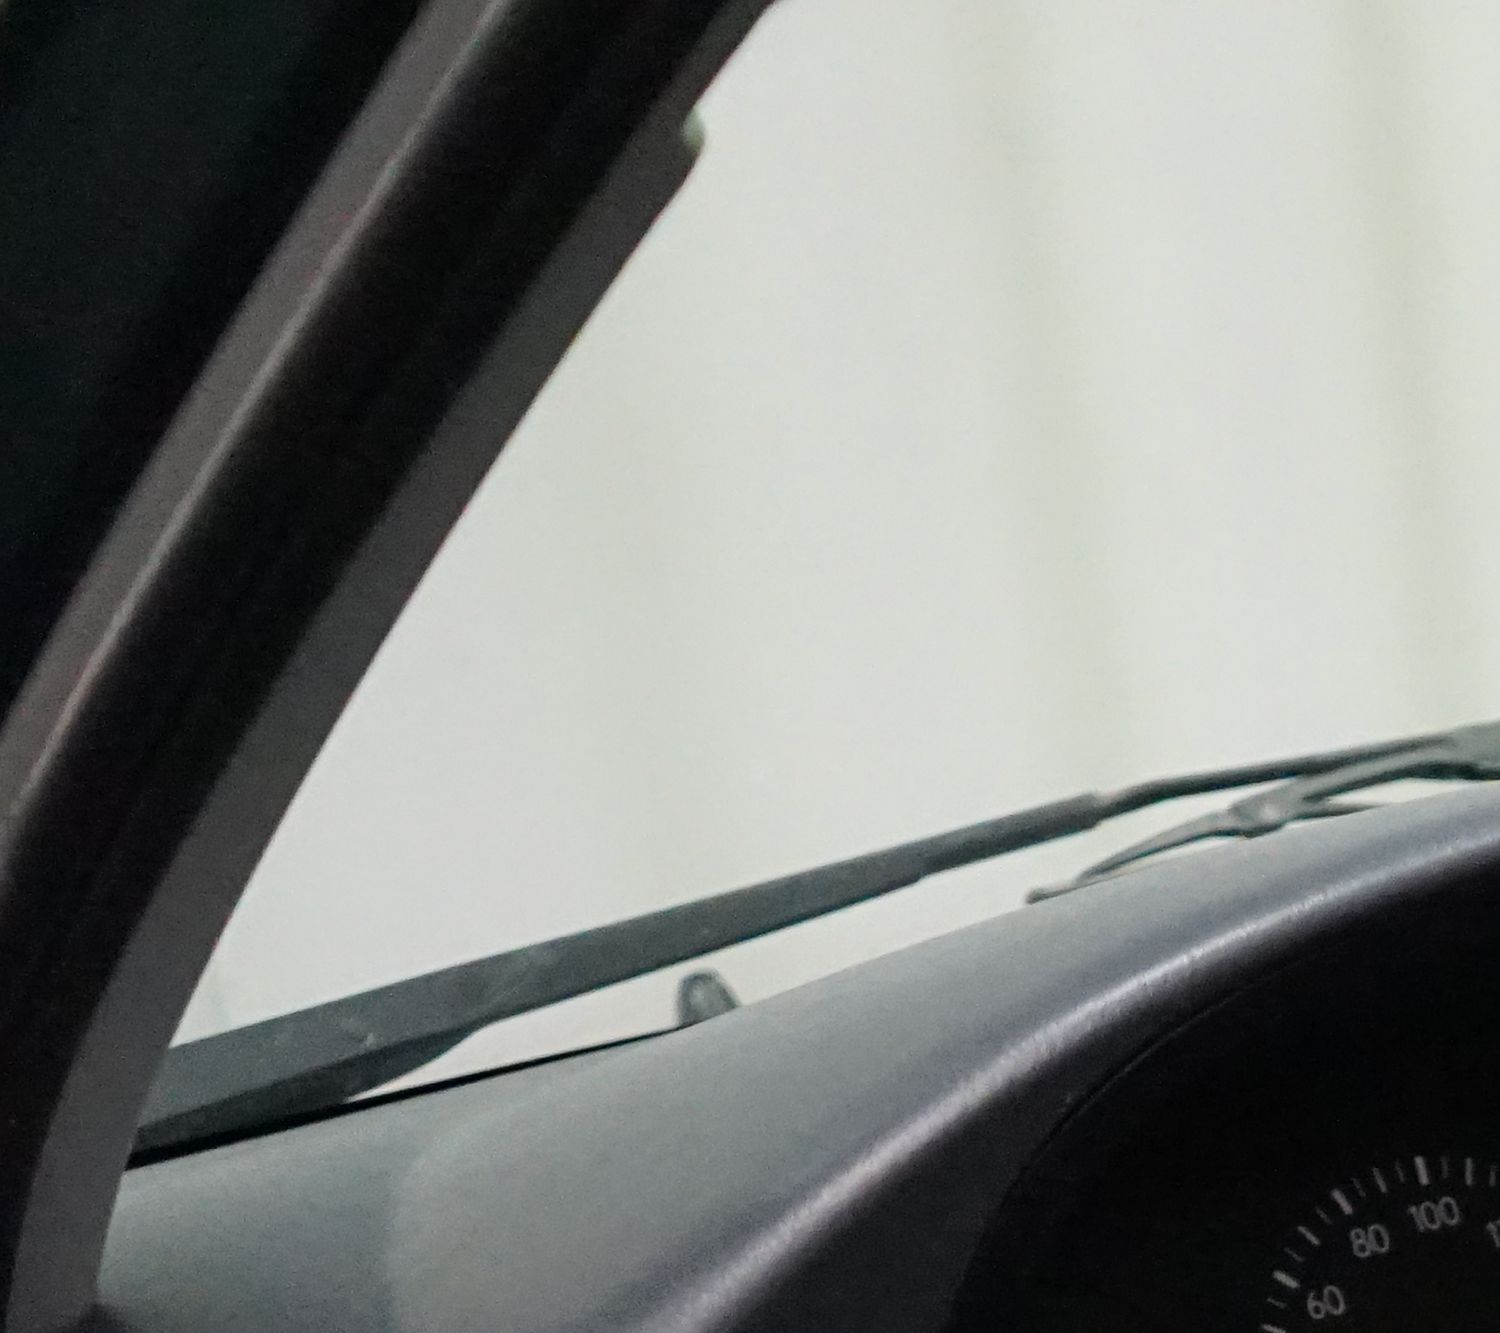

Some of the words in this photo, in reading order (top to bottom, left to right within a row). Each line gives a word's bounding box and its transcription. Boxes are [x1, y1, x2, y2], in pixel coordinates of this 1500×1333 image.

[1408, 1196, 1460, 1233] 100
[1351, 1223, 1390, 1258] 80
[1307, 1284, 1345, 1320] 60
